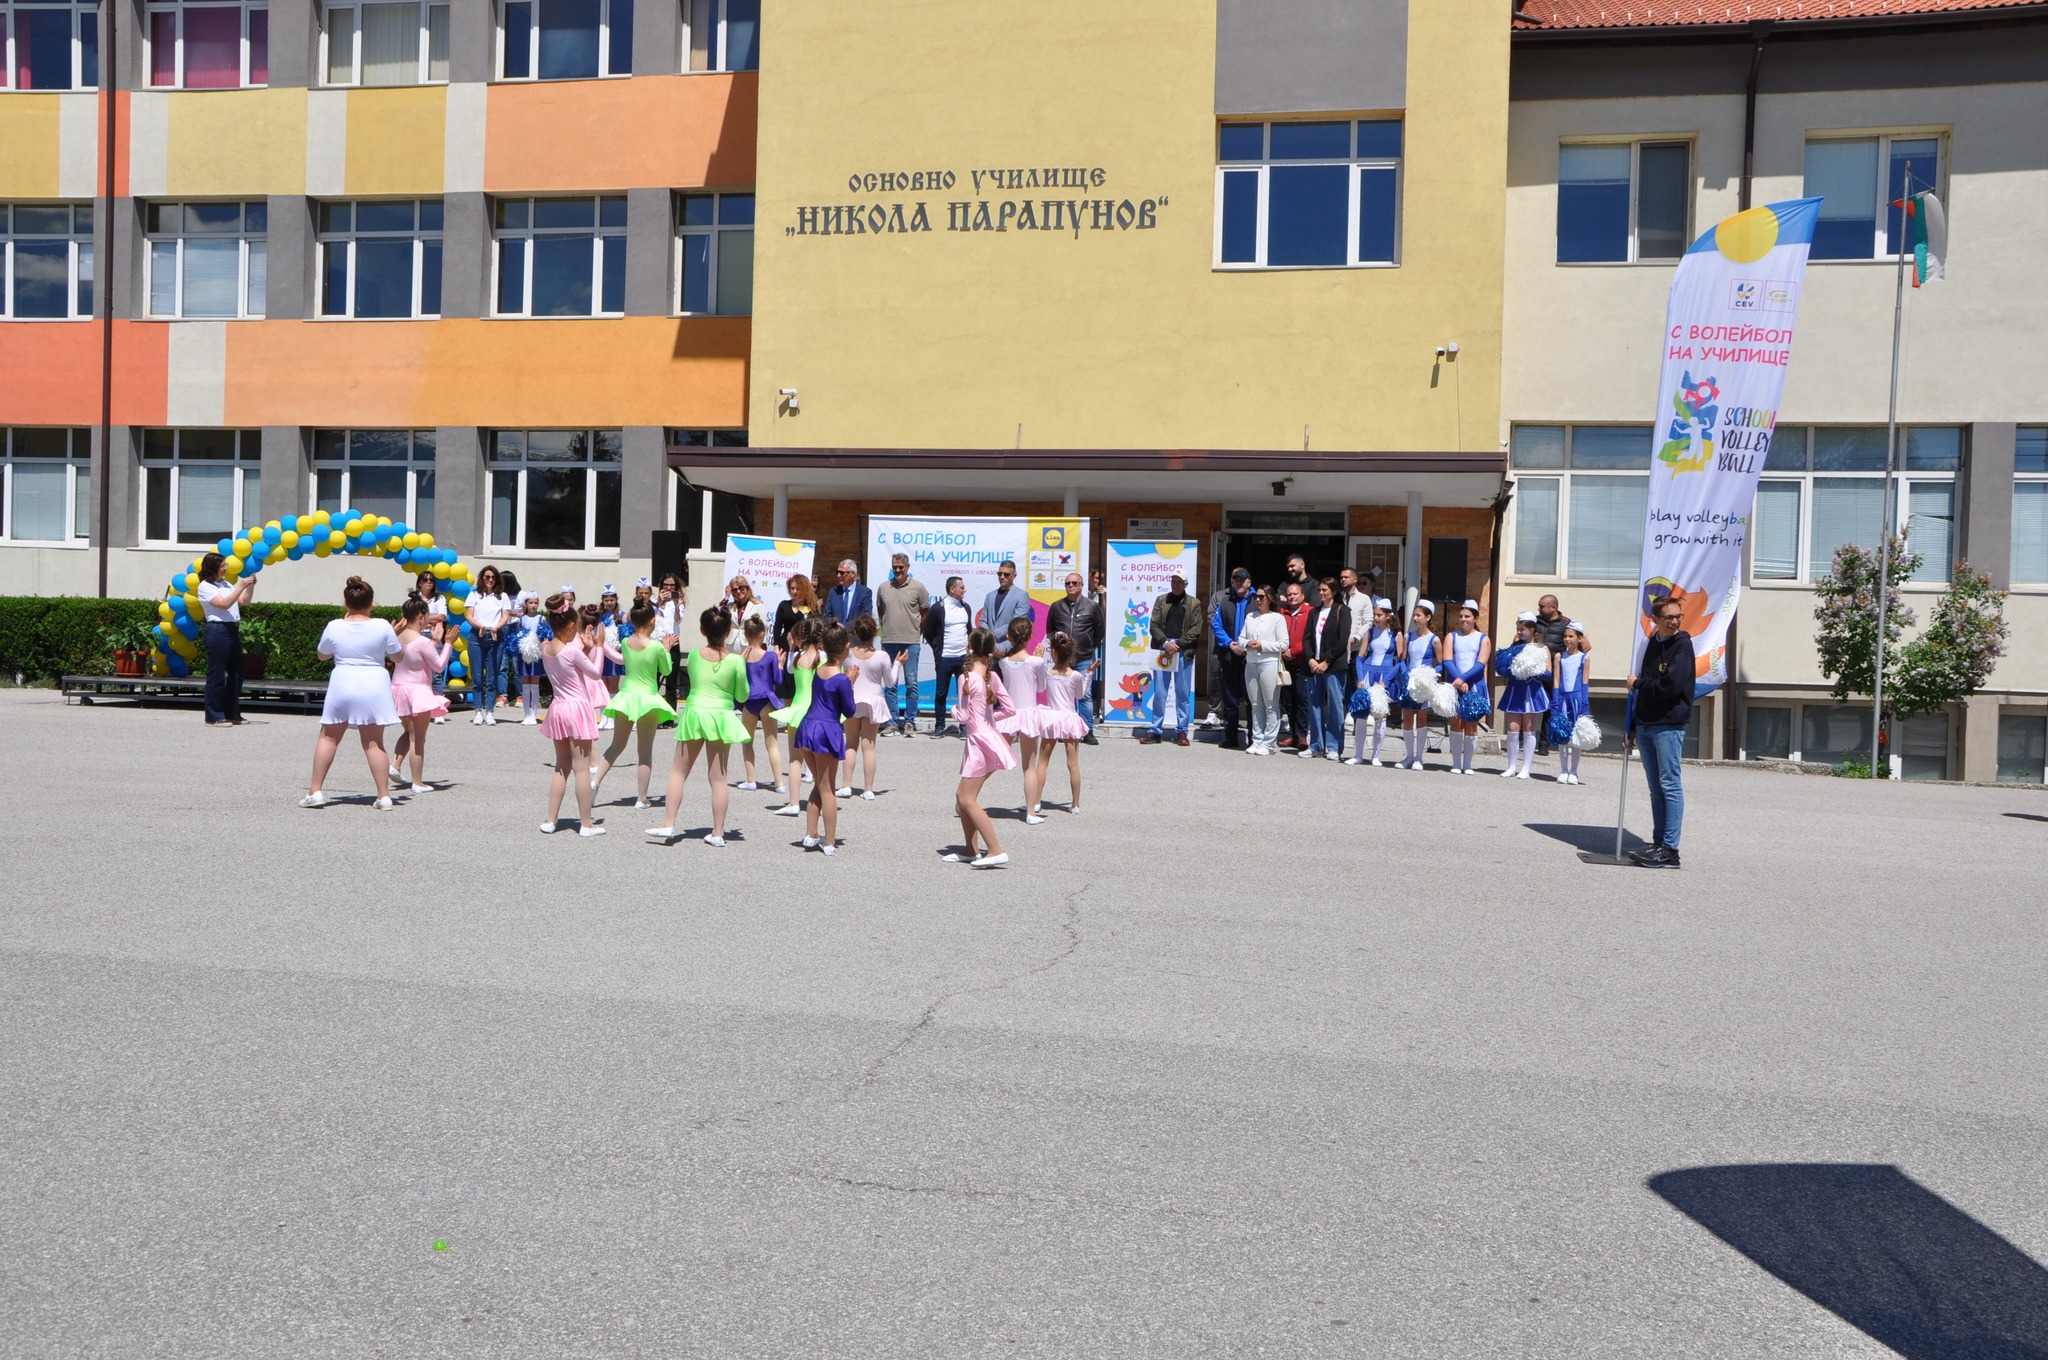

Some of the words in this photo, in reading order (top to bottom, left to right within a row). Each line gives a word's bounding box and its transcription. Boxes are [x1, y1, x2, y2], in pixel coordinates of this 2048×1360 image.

[848, 169, 957, 193] ОСНОВНО
[971, 167, 1107, 195] УЧИЛИЩЕ
[785, 201, 933, 238] „НИКОЛА
[947, 195, 1170, 239] ПАРАПУНОВ“
[1671, 324, 1681, 340] С
[1690, 324, 1793, 345] ВОЛЕЙБОЛ
[1669, 345, 1695, 362] НА
[1700, 346, 1790, 367] УЧИЛИЩЕ
[1724, 406, 1776, 430] SCHOOL
[1721, 429, 1773, 453] VOLLEY
[1717, 452, 1756, 474] BALL
[1650, 507, 1681, 530] play
[1686, 509, 1746, 532] volleyba
[878, 533, 887, 544] С
[893, 531, 976, 545] ВОЛЕЙБОЛ
[1654, 533, 1691, 550] grow
[1694, 530, 1729, 547] with
[1733, 532, 1744, 547] it
[738, 557, 745, 566] С
[748, 557, 799, 569] ВОЛЕЙБОЛ
[915, 550, 935, 562] НА
[941, 551, 1015, 564] УЧИЛИЩЕ
[1121, 563, 1127, 572] С
[738, 568, 752, 576] НА
